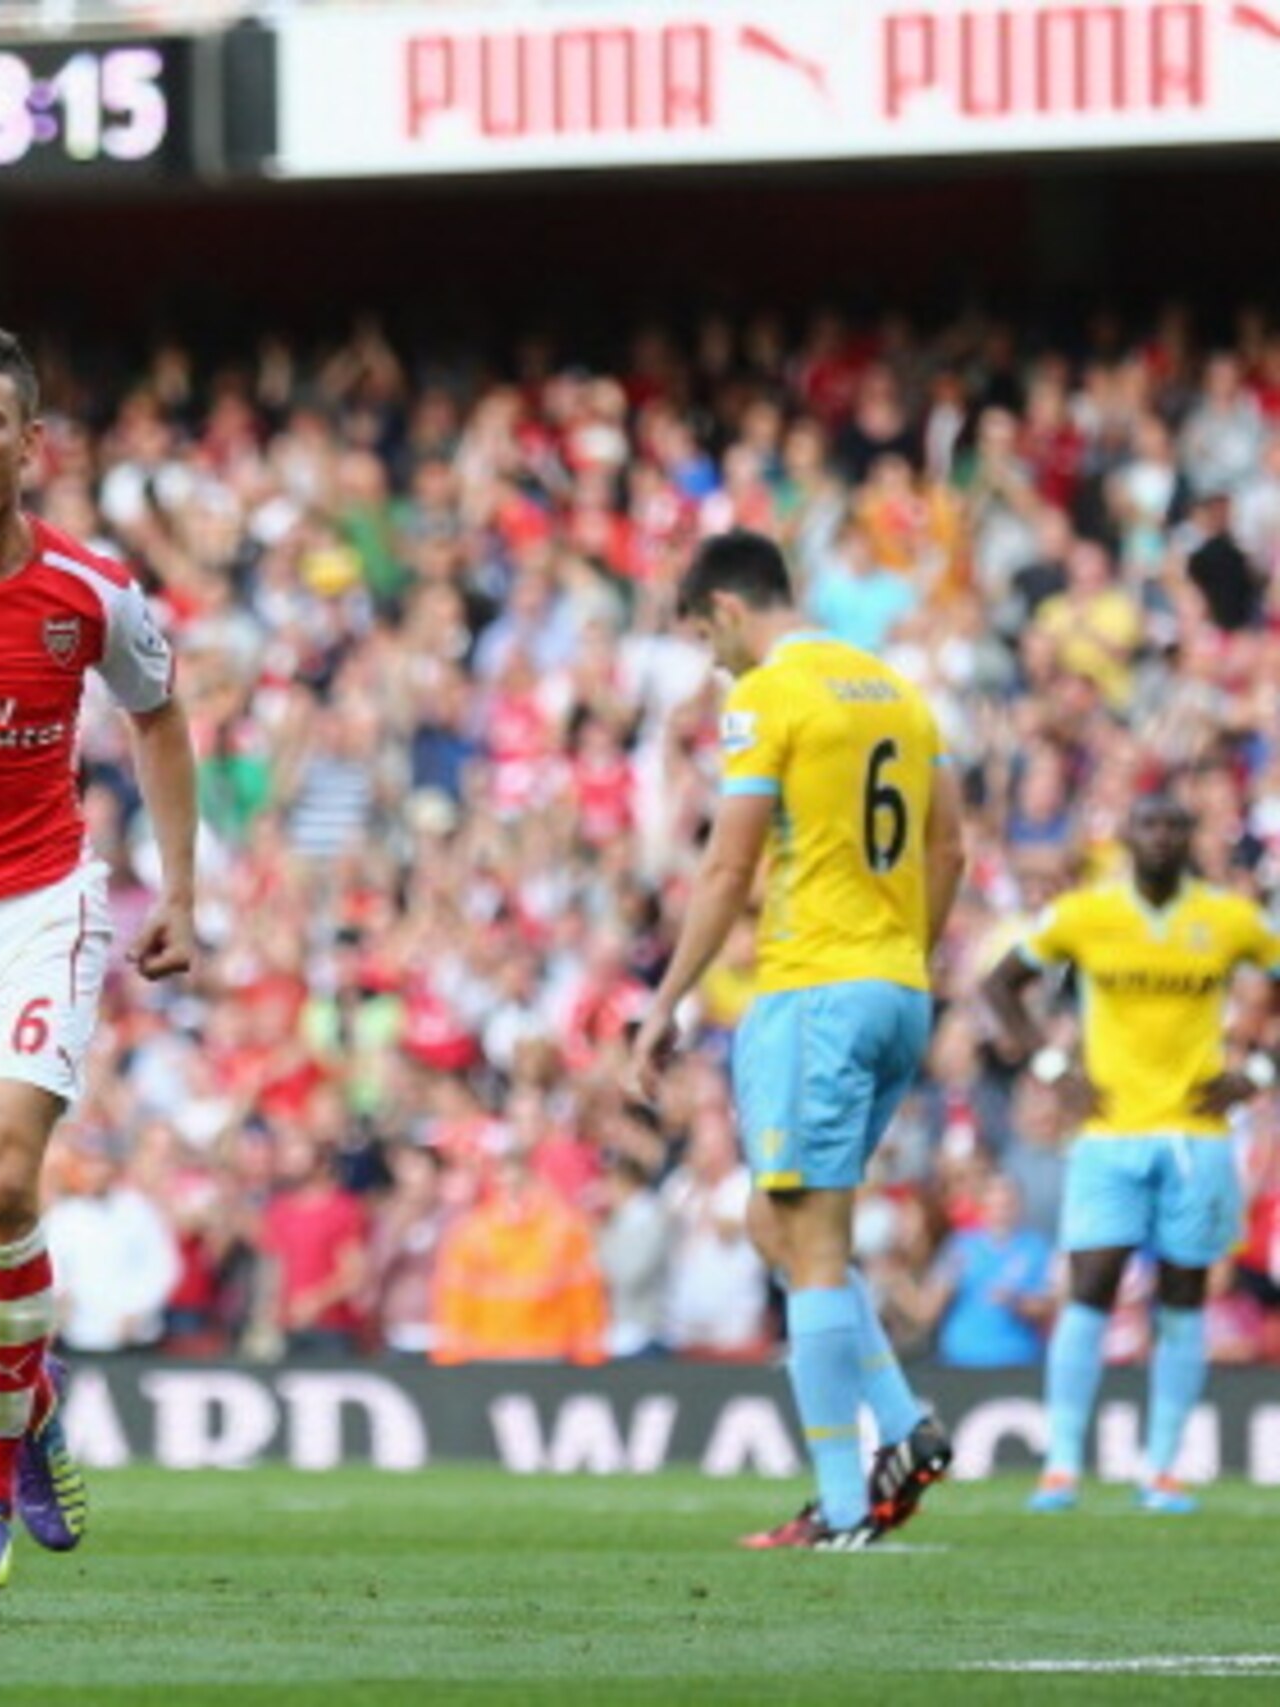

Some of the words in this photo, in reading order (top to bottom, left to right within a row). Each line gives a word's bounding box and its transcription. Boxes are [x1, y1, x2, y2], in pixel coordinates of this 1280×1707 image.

[404, 24, 713, 138] PUMA
[883, 4, 1208, 120] PUMA
[864, 738, 908, 873] 6
[11, 997, 53, 1055] 6
